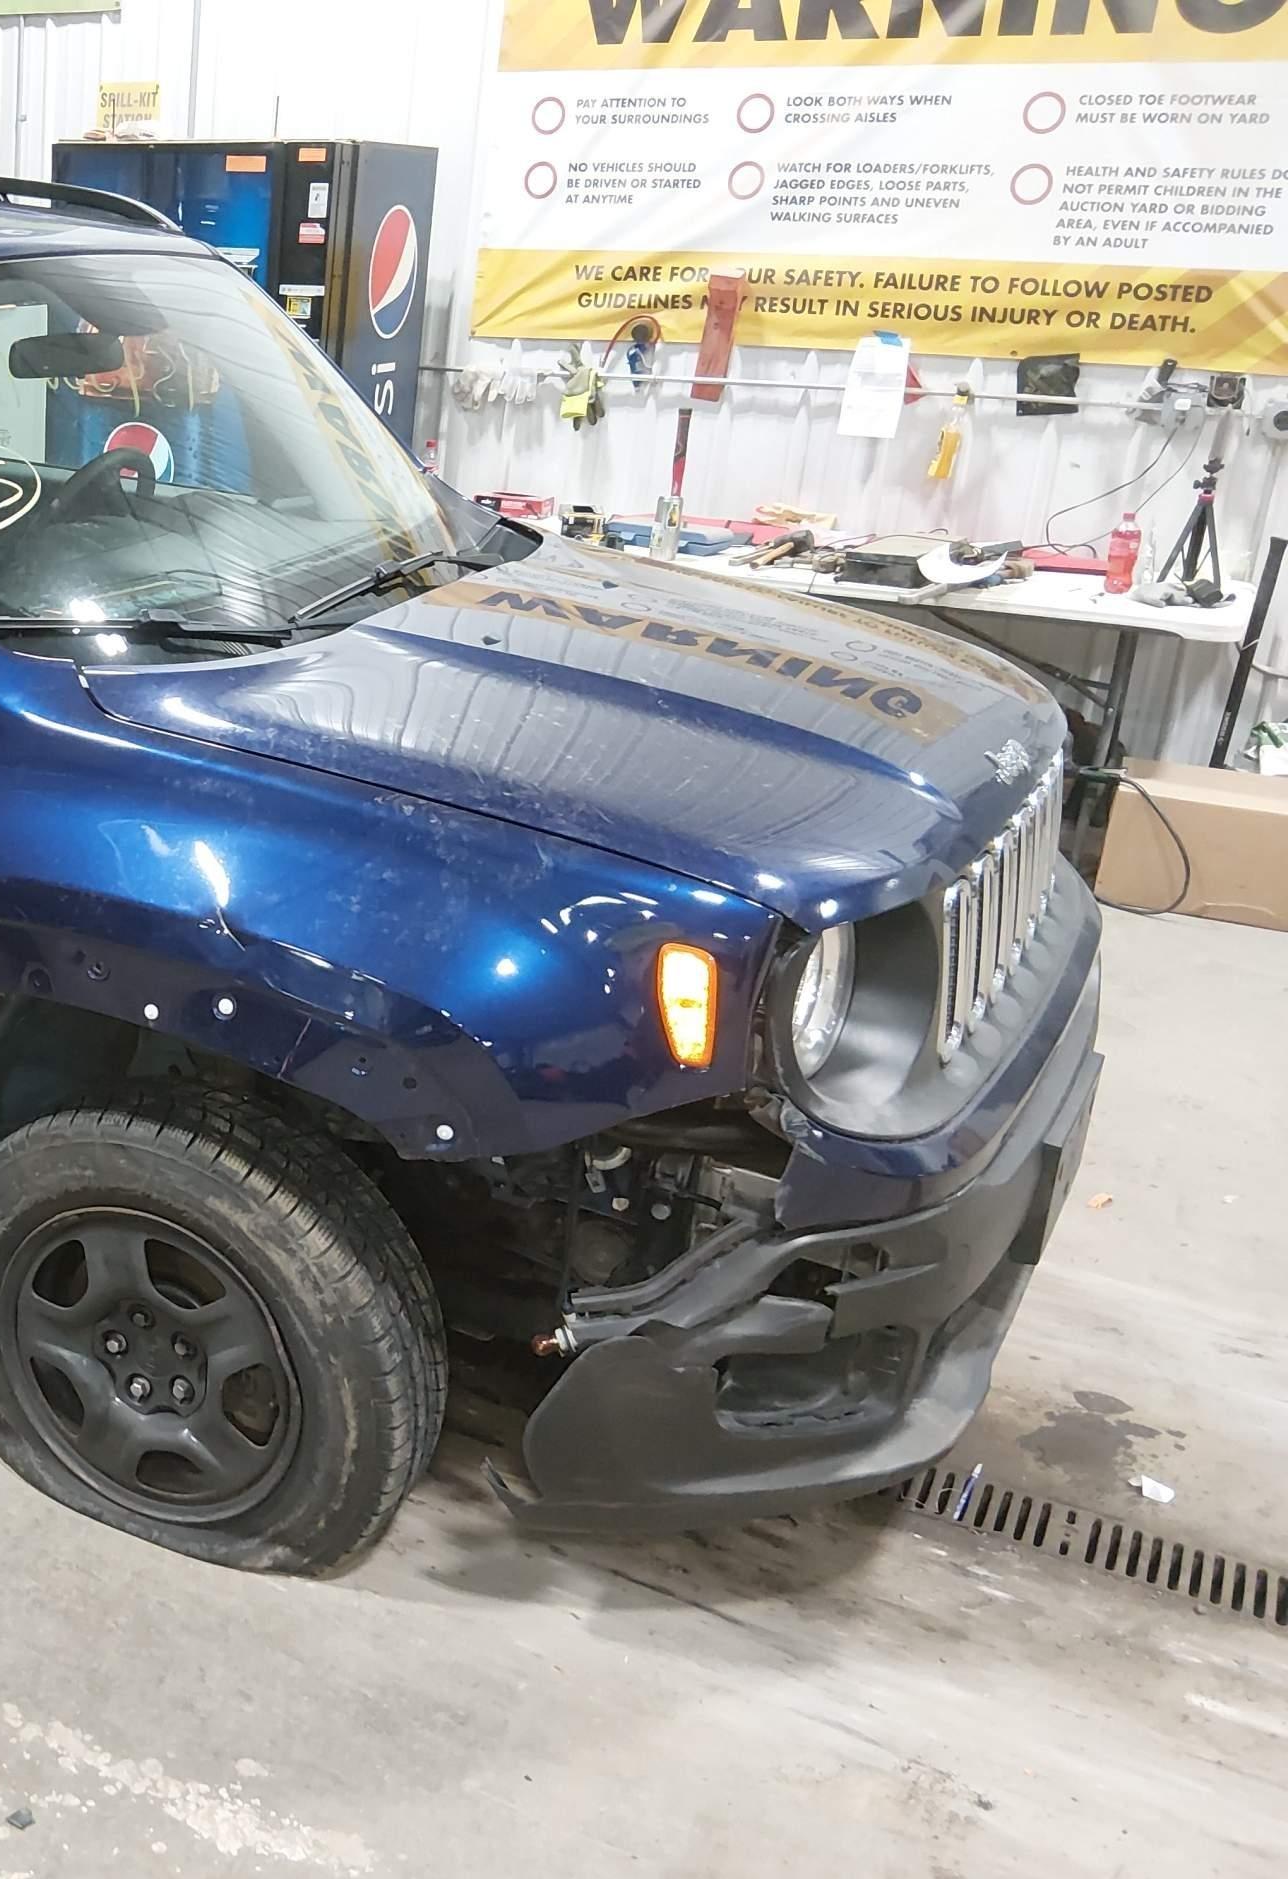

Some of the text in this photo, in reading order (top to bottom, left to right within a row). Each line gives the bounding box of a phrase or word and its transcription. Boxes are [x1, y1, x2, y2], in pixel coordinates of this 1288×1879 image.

[100, 92, 158, 108] SPILL-KIT
[576, 97, 687, 109] PAY ATTENTION TO
[786, 95, 952, 107] LOOK BOTH WAYS WHEN
[1079, 94, 1257, 106] CLOSED TOE FOOTWEAR
[575, 113, 710, 125] YOUR SURROUNDINGS
[784, 112, 897, 124] CROSSING AISLES
[1075, 112, 1270, 124] MUST BE WORN ON YARD
[568, 162, 697, 173] NO VEHICLES SHOULD
[777, 162, 995, 177] WATCH FOR LOADERS/FORKLIFTS,
[1066, 166, 1119, 177] HEALTH
[1123, 167, 1158, 178] AND
[1162, 167, 1216, 179] SAFETY
[1220, 168, 1267, 180] RULES
[567, 178, 702, 189] BE DRIVEN OR STARTED
[773, 179, 970, 193] JAGGED EDGES, LOOSE PARTS,
[1062, 183, 1283, 199] NOT PERMIT CHILDREN IN THE
[565, 194, 634, 205] AT ANYTIME
[772, 195, 961, 209] SHARP POINTS AND UNEVEN
[1059, 201, 1267, 217] AUCTION YARD OR BIDDING
[770, 211, 899, 224] WALKING SURFACES
[1055, 218, 1274, 235] AREA, EVEN IF ACCOMPANIED
[1053, 235, 1149, 249] BY AN ADULT
[575, 265, 605, 281] WE
[611, 265, 663, 282] CARE
[669, 266, 710, 282] FOR
[783, 269, 865, 288] SAFETY.
[873, 271, 961, 292] FAILURE
[969, 275, 1000, 294] TO
[1007, 277, 1111, 299] FOLLOW
[1116, 281, 1213, 304] POSTED
[577, 291, 693, 310] GUIDELINES
[754, 296, 829, 315] RESULT
[835, 299, 859, 317] IN
[867, 301, 963, 322] SERIOUS
[970, 306, 1060, 326] INJURY
[1065, 310, 1102, 329] OR
[1109, 312, 1197, 333] DEATH.
